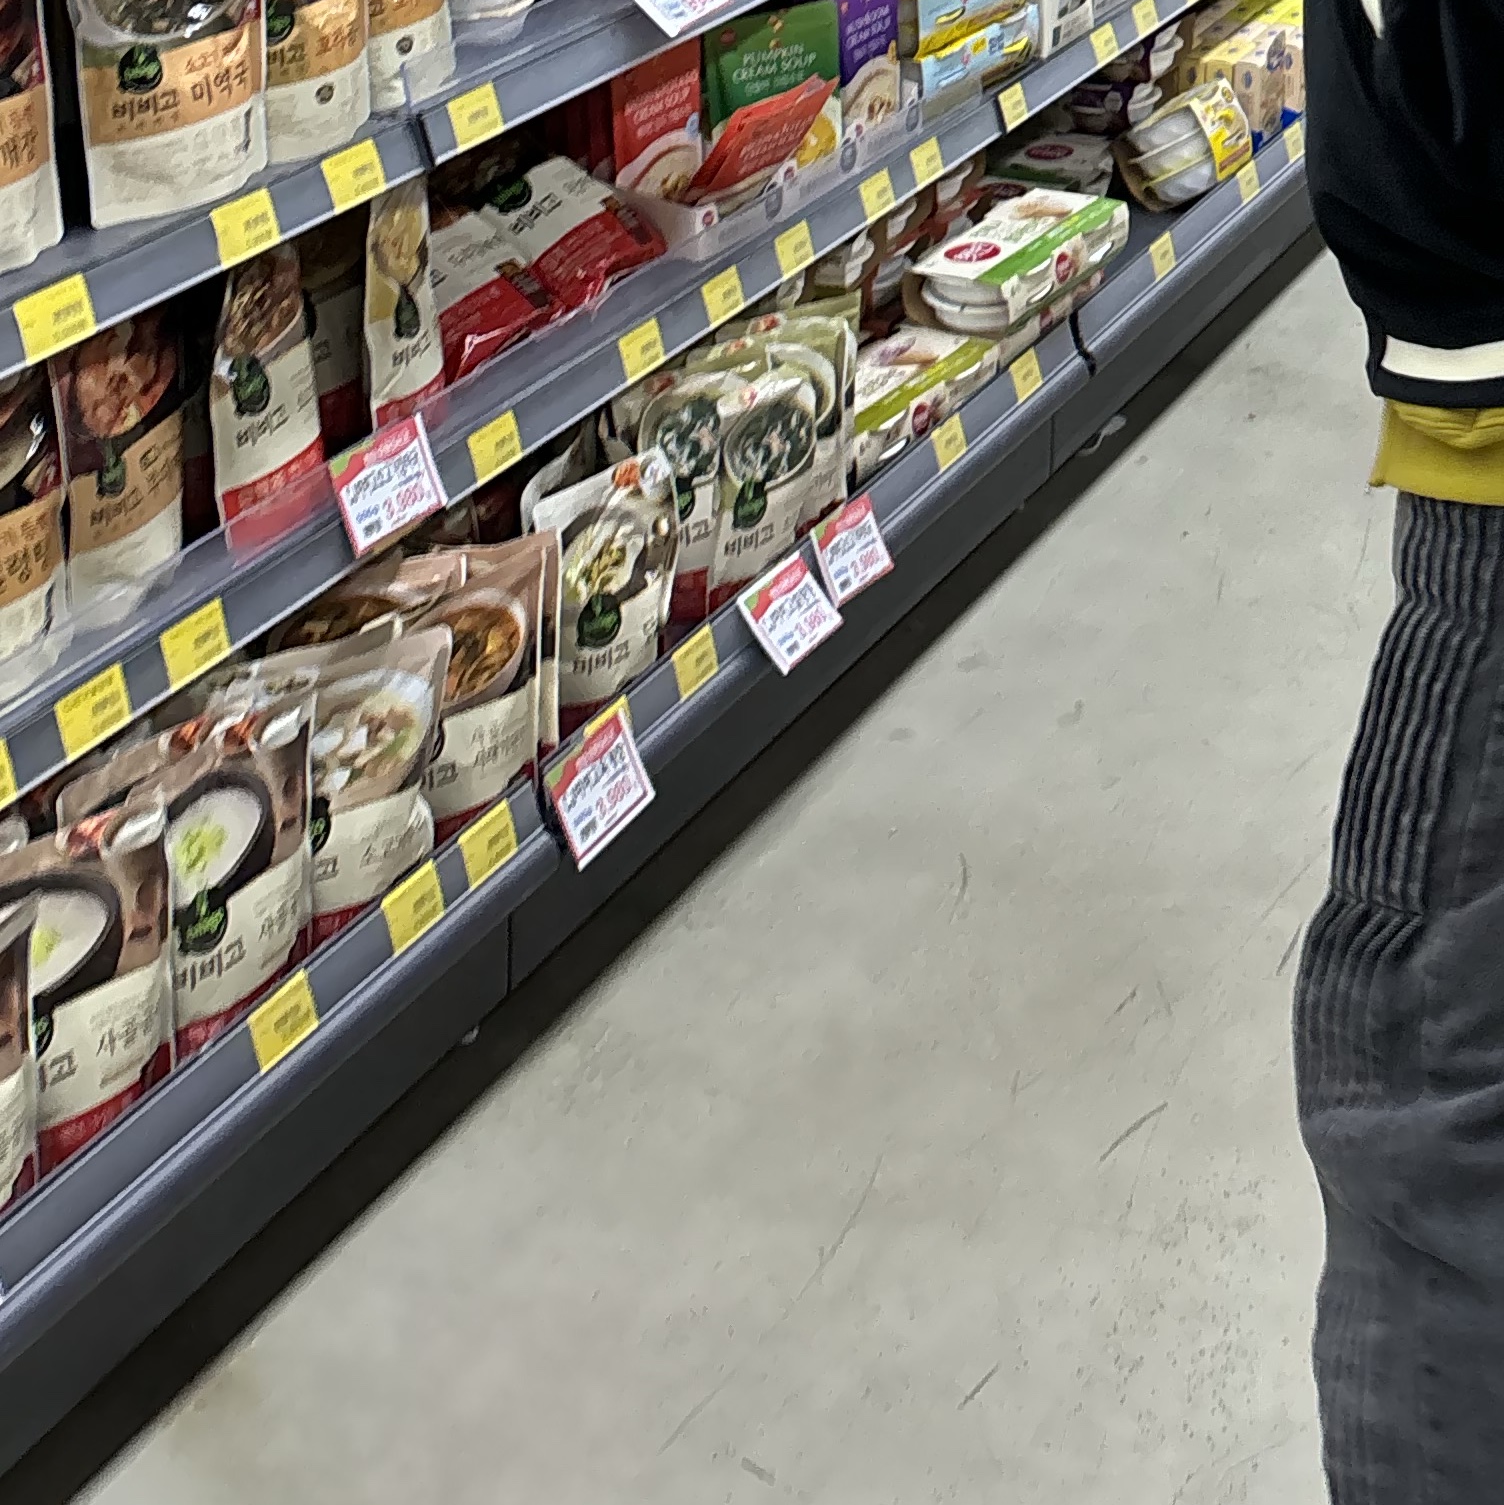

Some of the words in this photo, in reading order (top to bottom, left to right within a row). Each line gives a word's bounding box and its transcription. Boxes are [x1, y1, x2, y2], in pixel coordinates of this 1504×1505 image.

[111, 83, 181, 121] 비비고
[189, 64, 250, 109] 미역국
[509, 192, 562, 236] 비비고
[391, 332, 432, 369] 비비고
[235, 403, 290, 448] 비비고
[89, 489, 143, 528] 비비고
[724, 522, 775, 557] 비비고
[572, 640, 630, 675] 비비고
